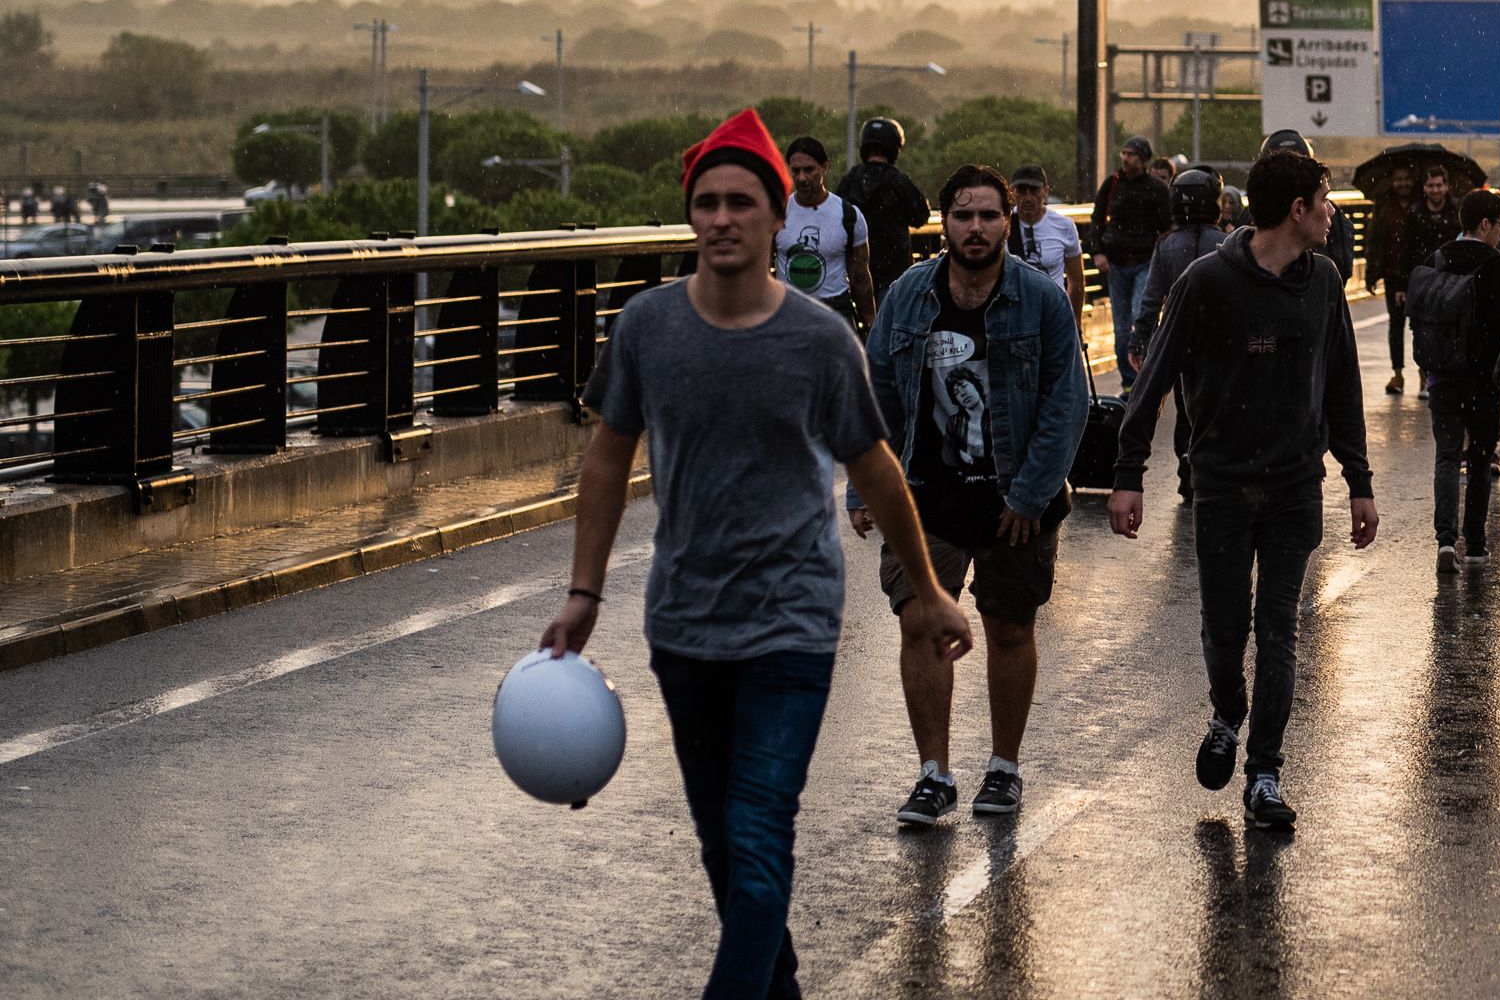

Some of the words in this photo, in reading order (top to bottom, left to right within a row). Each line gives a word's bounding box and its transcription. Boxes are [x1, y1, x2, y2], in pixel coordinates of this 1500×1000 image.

[1297, 39, 1368, 52] Arribades
[1297, 55, 1358, 69] Llegadas
[1311, 80, 1329, 100] P
